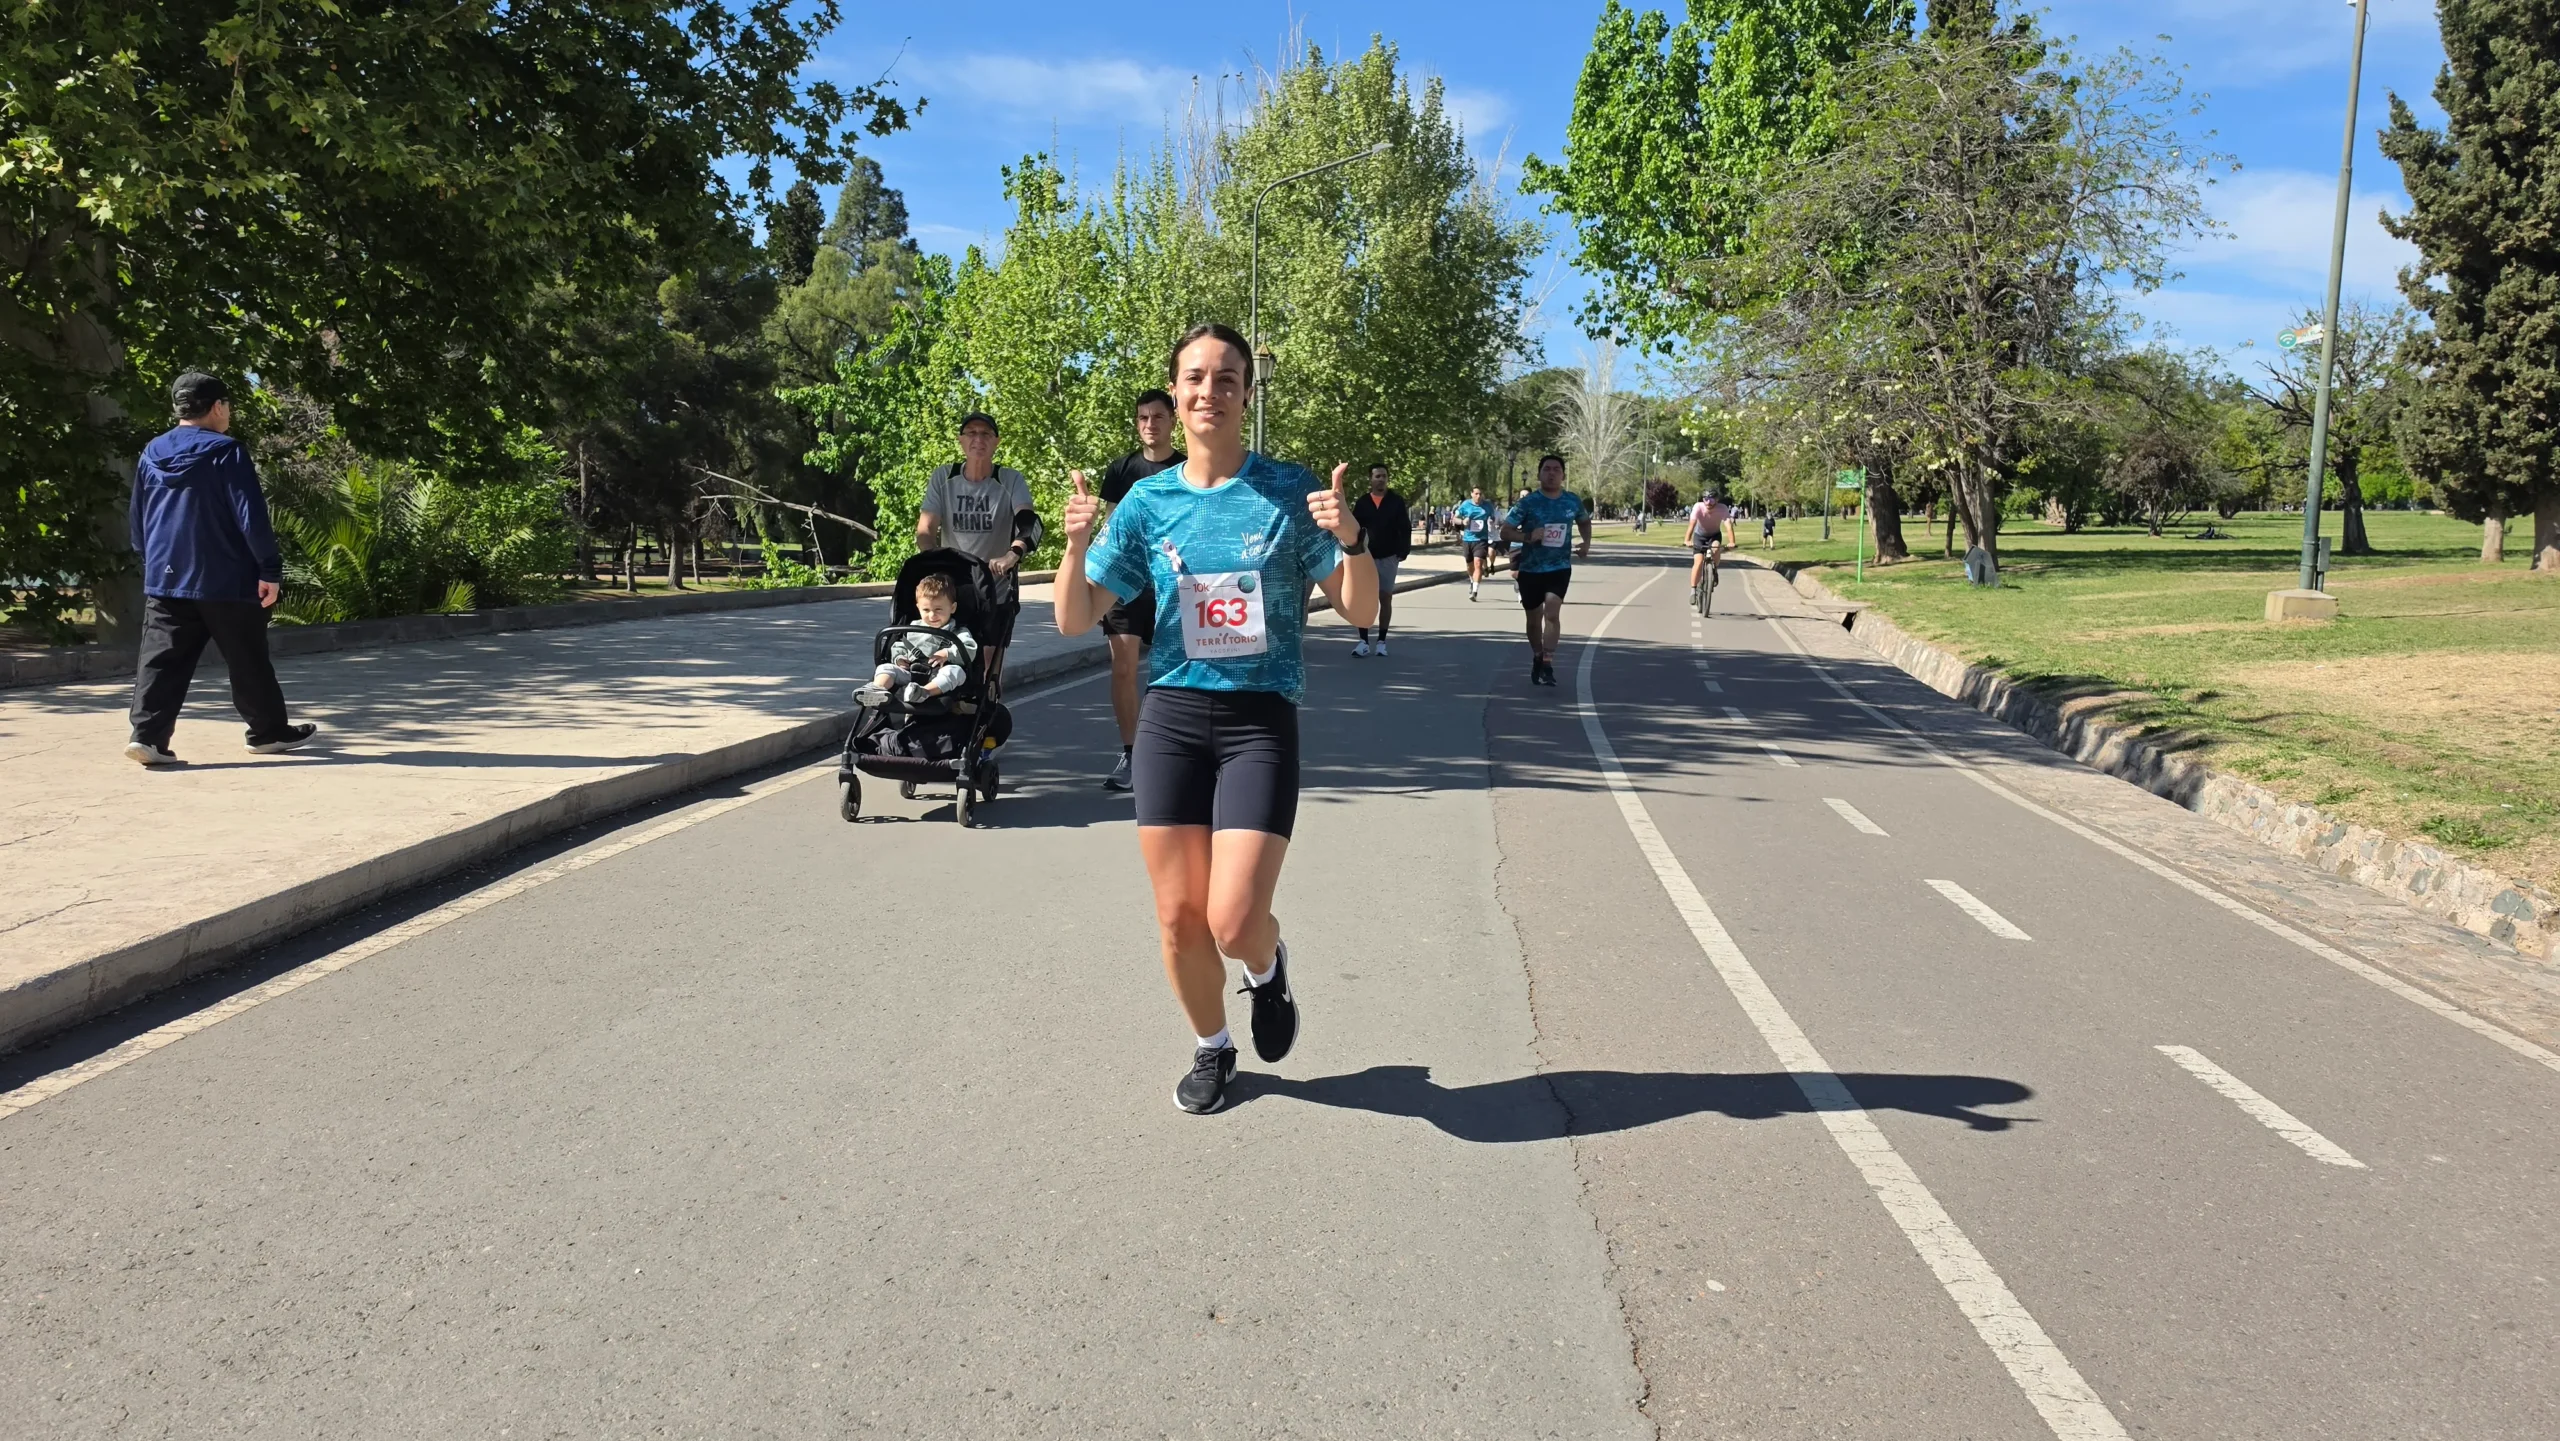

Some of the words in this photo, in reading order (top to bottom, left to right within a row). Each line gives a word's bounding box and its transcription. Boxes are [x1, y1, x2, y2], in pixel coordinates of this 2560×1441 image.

[957, 495, 990, 511] TRAI
[953, 513, 993, 530] NING
[1546, 530, 1562, 539] 201
[1193, 583, 1210, 593] 10k
[1195, 597, 1248, 628] 163
